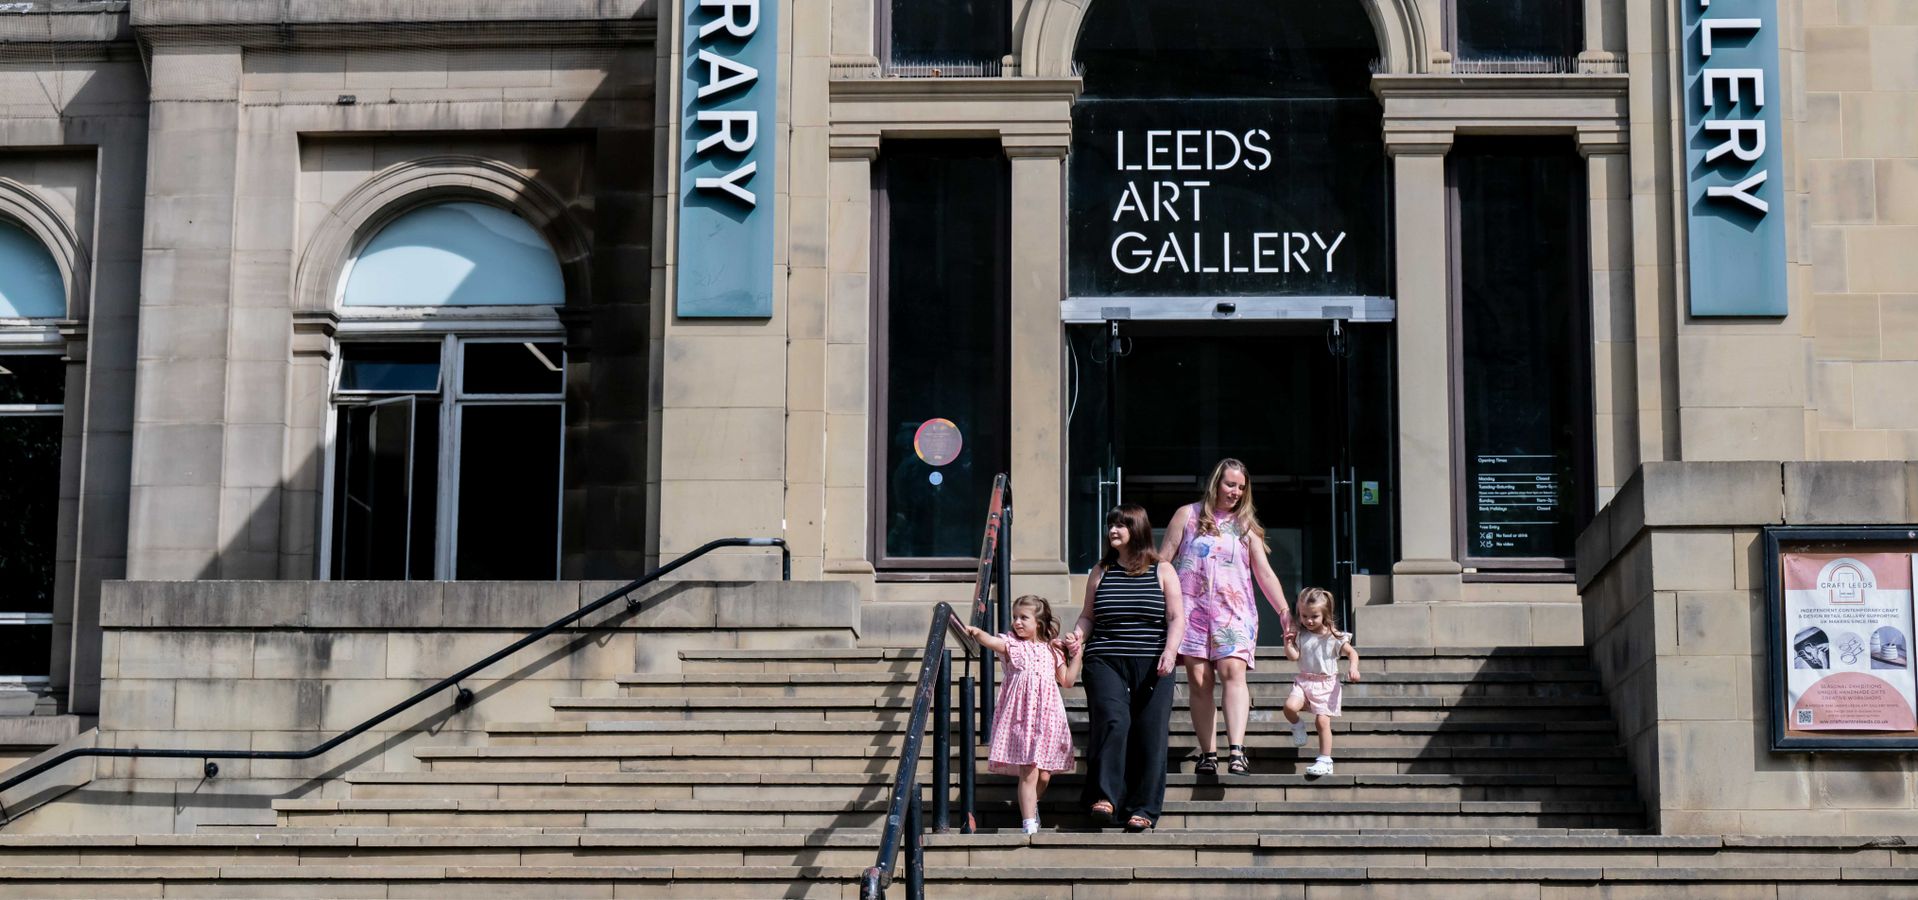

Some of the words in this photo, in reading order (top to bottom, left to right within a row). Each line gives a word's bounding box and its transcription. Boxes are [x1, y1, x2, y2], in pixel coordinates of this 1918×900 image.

[1701, 0, 1768, 213] LERY
[1117, 129, 1272, 171] LEEDS
[1112, 181, 1210, 222] ART
[1111, 231, 1346, 273] GALLERY
